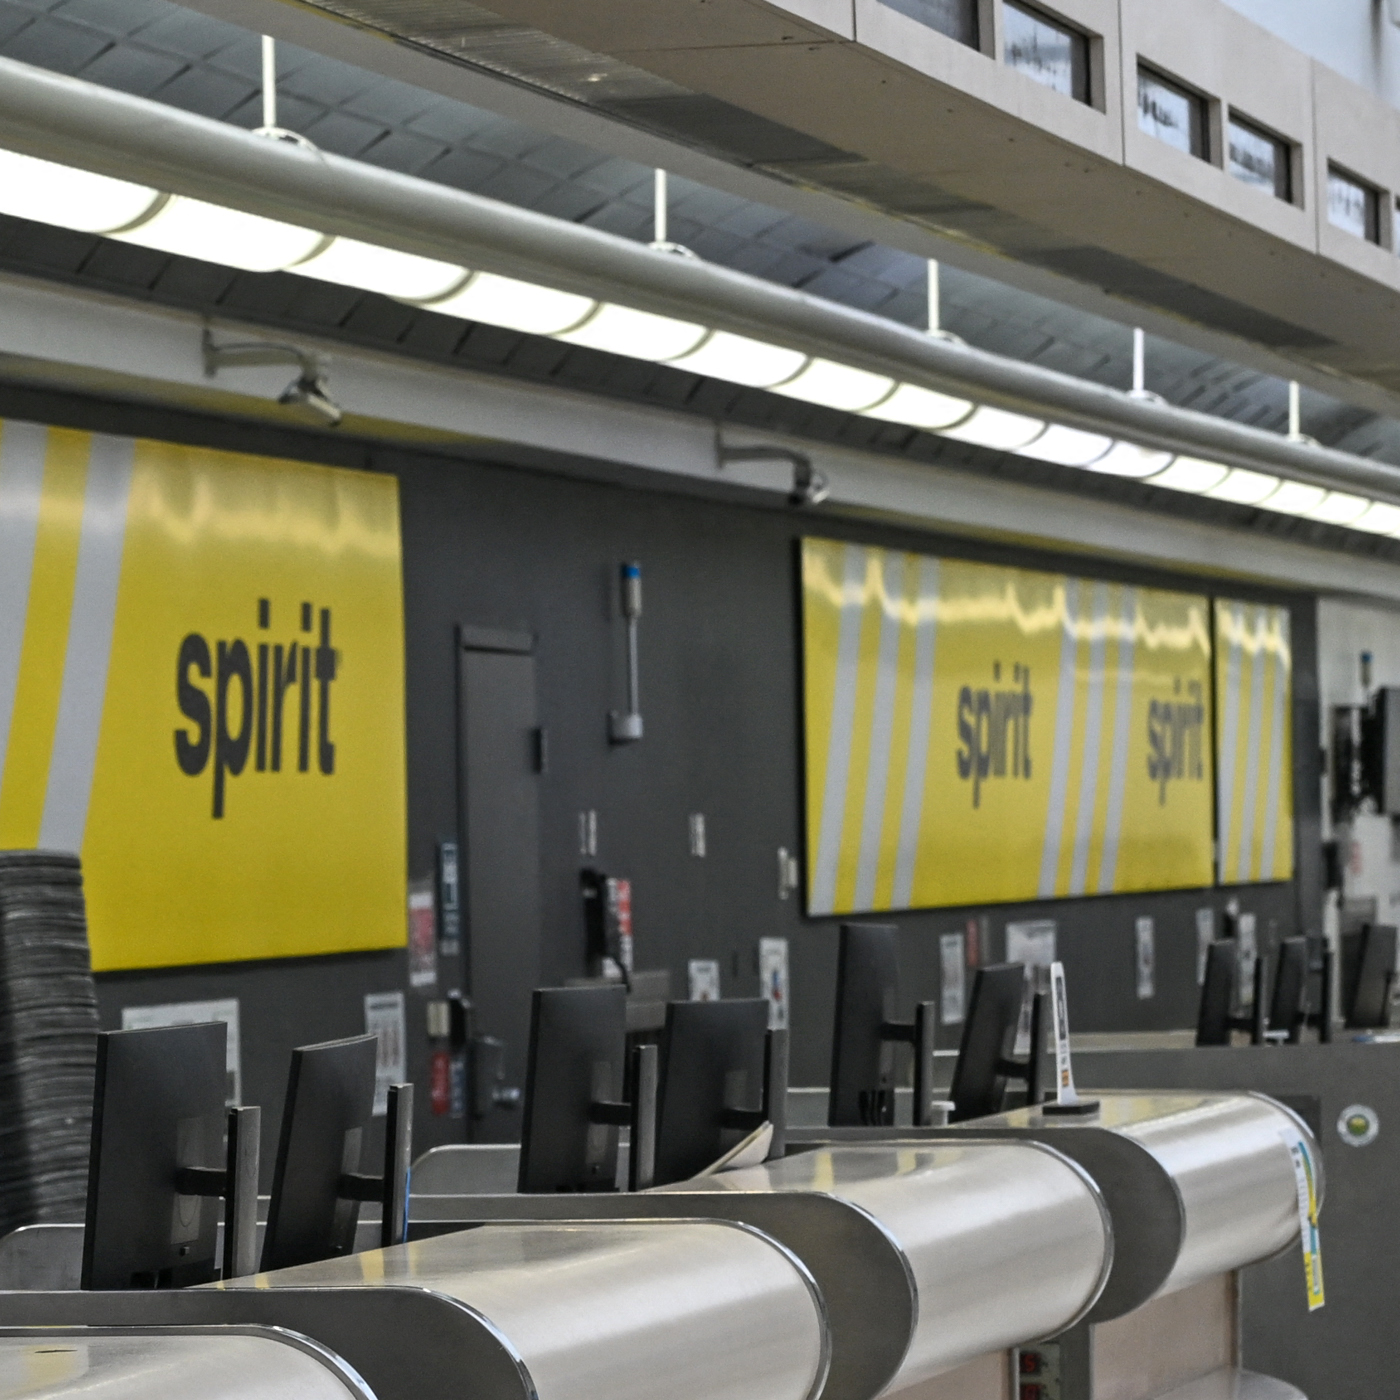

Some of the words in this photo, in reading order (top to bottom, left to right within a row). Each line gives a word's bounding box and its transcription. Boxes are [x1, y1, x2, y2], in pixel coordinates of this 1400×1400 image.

[174, 597, 337, 820] spirit
[955, 659, 1033, 810] spirit
[1146, 675, 1204, 807] spirit
